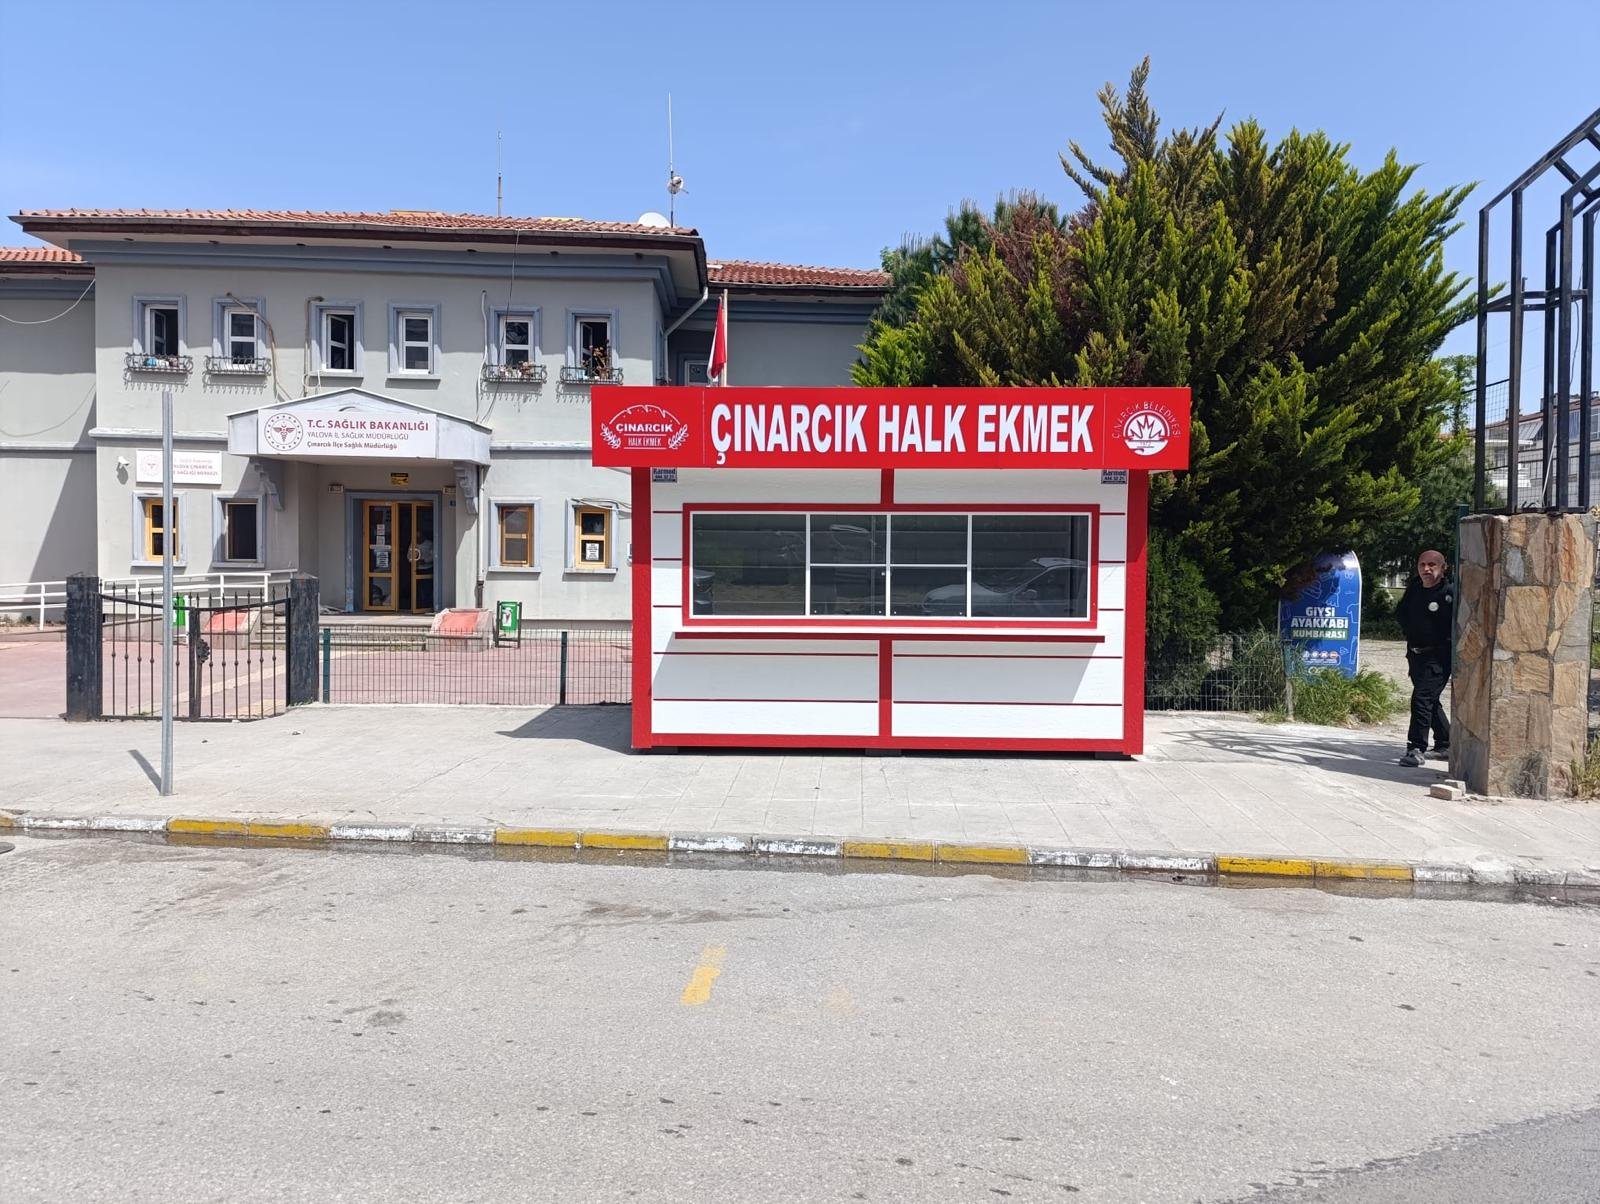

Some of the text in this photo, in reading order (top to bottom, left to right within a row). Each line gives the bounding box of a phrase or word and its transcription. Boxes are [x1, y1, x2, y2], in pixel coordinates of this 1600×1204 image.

[307, 419, 429, 431] T.C. SAĞLIK BAKANLIĞI
[307, 431, 334, 439] YALOVA
[341, 431, 364, 439] SAĞLIK
[366, 432, 409, 440] MÜDÜRLÜĞÜ
[710, 403, 1094, 465] ÇINARCIK HALK EKMEK
[307, 441, 331, 449] Çınarcık
[344, 441, 363, 449] Sağlık
[628, 436, 662, 446] HALK EKMEK
[1290, 618, 1349, 629] AYAKKABI
[1292, 629, 1346, 639] KUMBARASI
